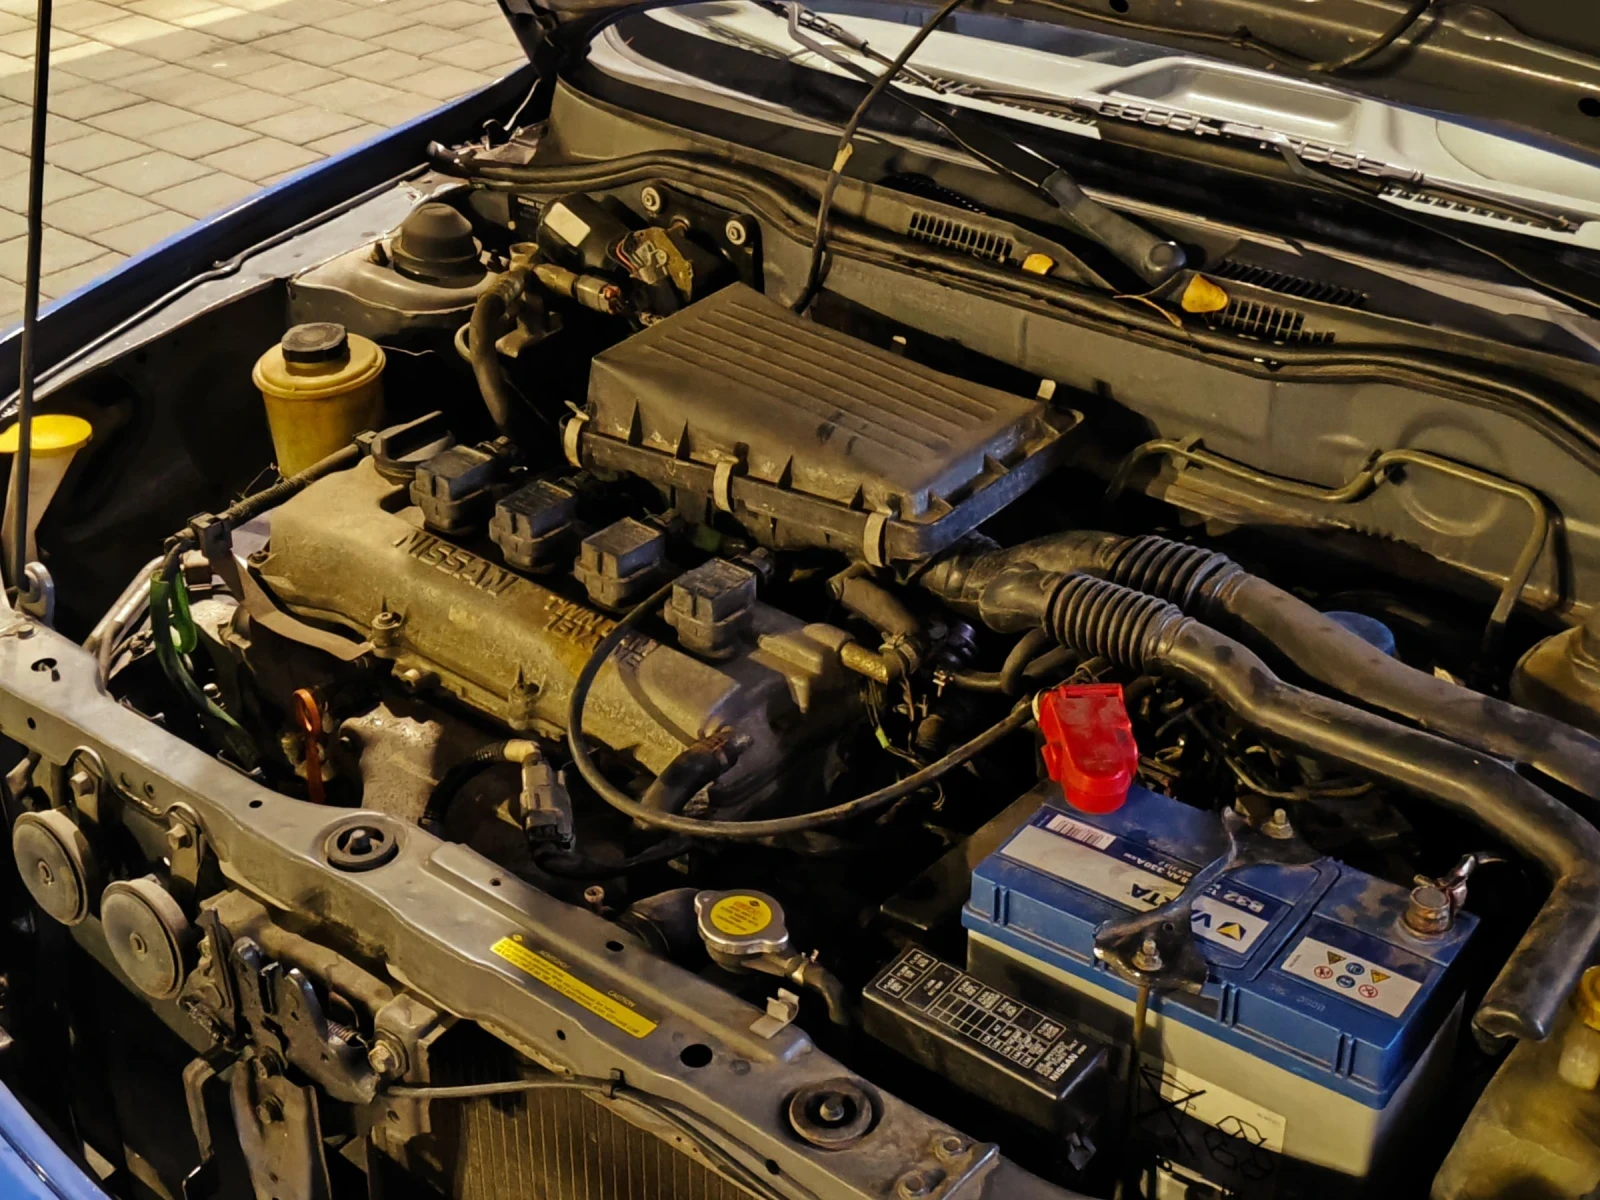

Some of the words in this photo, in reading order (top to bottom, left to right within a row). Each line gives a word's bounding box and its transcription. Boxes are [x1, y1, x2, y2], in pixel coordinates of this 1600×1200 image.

[392, 530, 520, 597] NISSAN
[1131, 883, 1212, 929] VTA
[1223, 890, 1265, 913] B32
